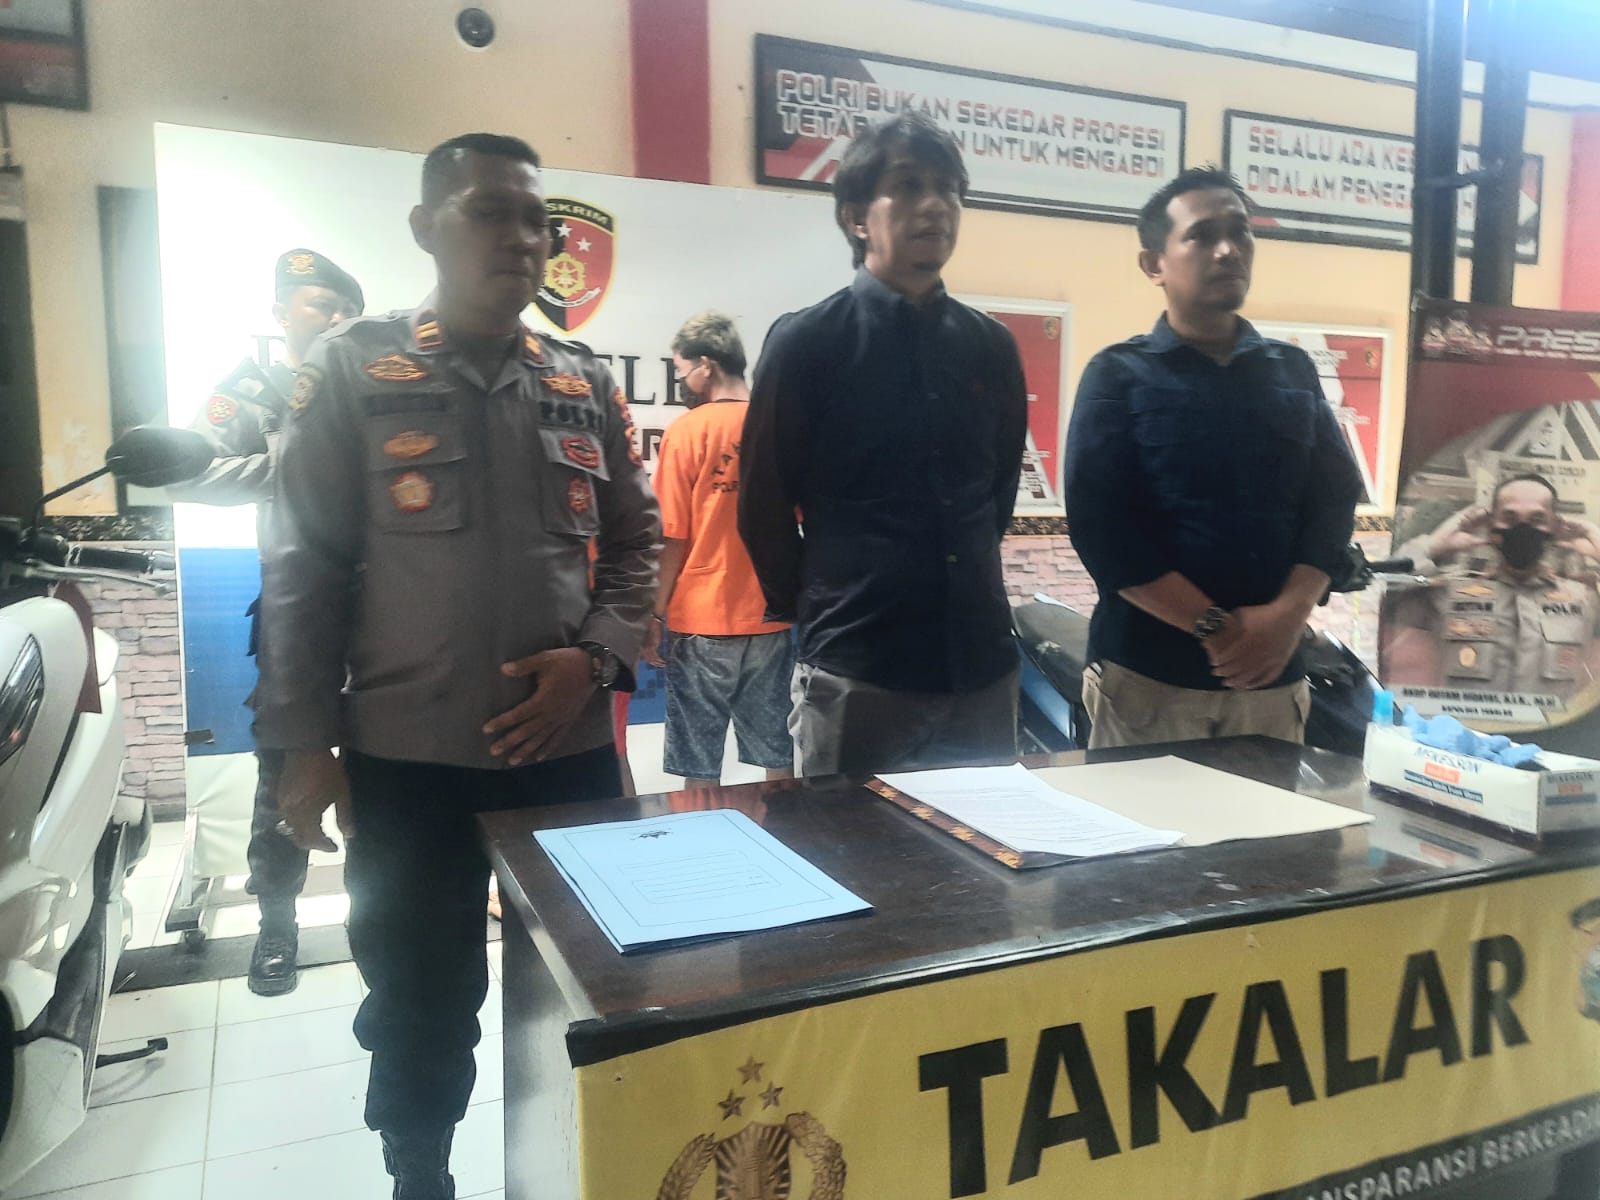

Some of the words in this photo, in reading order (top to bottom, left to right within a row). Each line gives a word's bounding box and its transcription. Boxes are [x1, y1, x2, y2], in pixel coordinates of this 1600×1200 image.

[777, 70, 860, 112] POLRI
[864, 85, 950, 121] BUKAN
[957, 101, 1065, 139] SEKEDAR
[1073, 118, 1166, 152] PROFESI
[777, 102, 868, 141] TETAP
[972, 135, 1050, 166] UNTUK
[1056, 146, 1166, 179] MENGABDI
[1248, 125, 1333, 162] SELALU
[1339, 138, 1377, 168] ADA
[1247, 163, 1338, 201] DIDALAM
[1340, 175, 1412, 210] PENEG
[545, 202, 609, 225] SKRIM
[1497, 326, 1600, 354] PRES
[918, 934, 1531, 1199] TAKALAR
[1305, 1147, 1477, 1200] NSPARANSI
